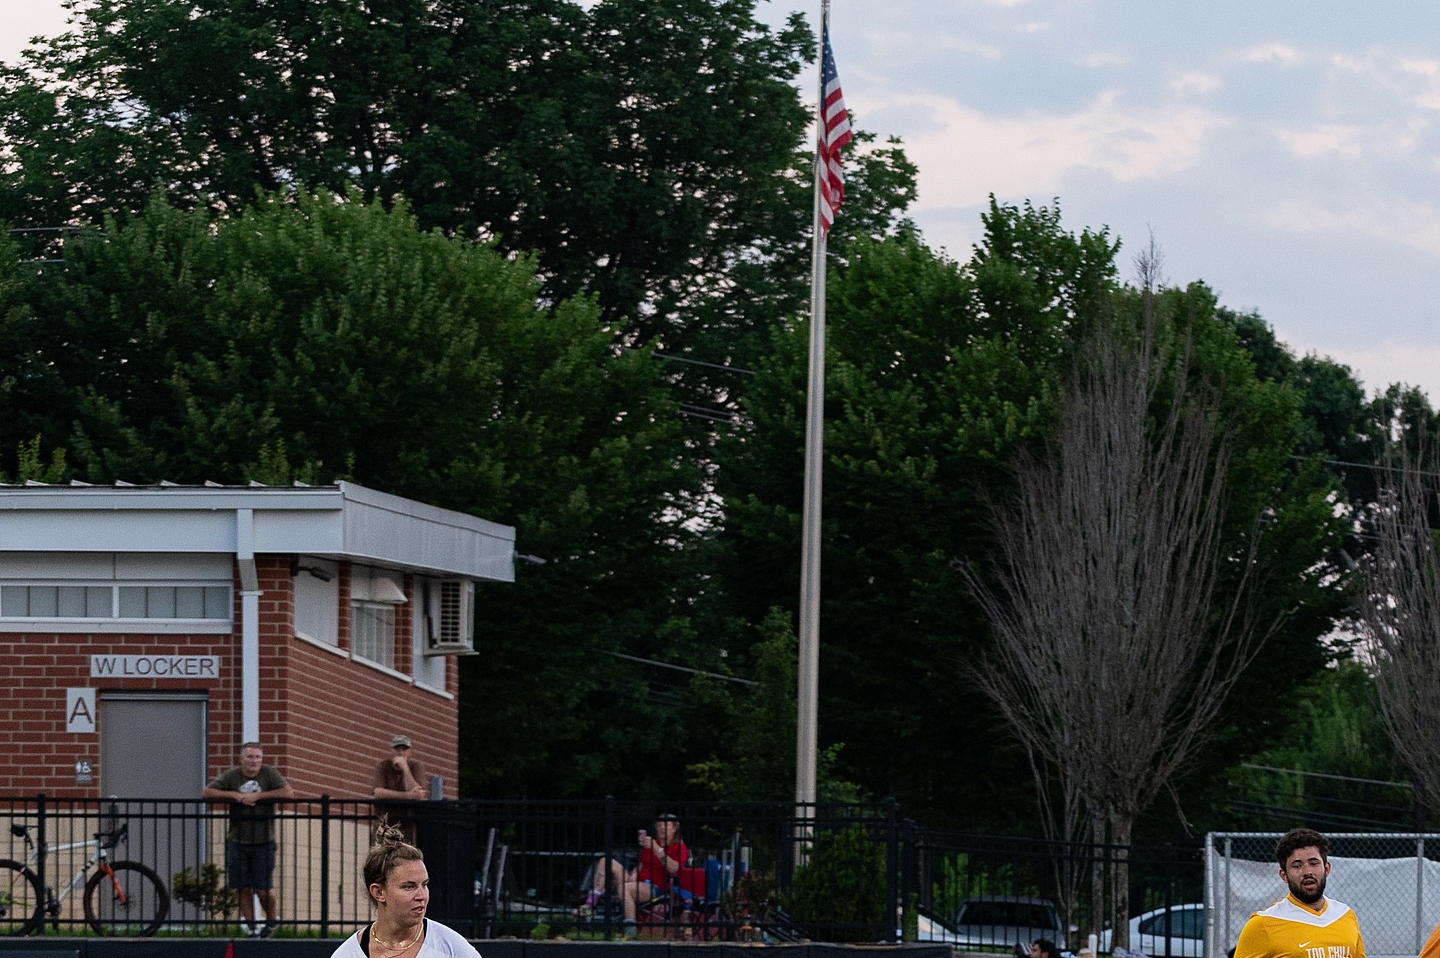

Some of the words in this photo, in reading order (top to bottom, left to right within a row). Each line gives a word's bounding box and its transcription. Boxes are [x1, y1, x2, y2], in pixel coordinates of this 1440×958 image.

[95, 657, 116, 674] W
[123, 657, 215, 676] LOCKER
[69, 696, 94, 724] A
